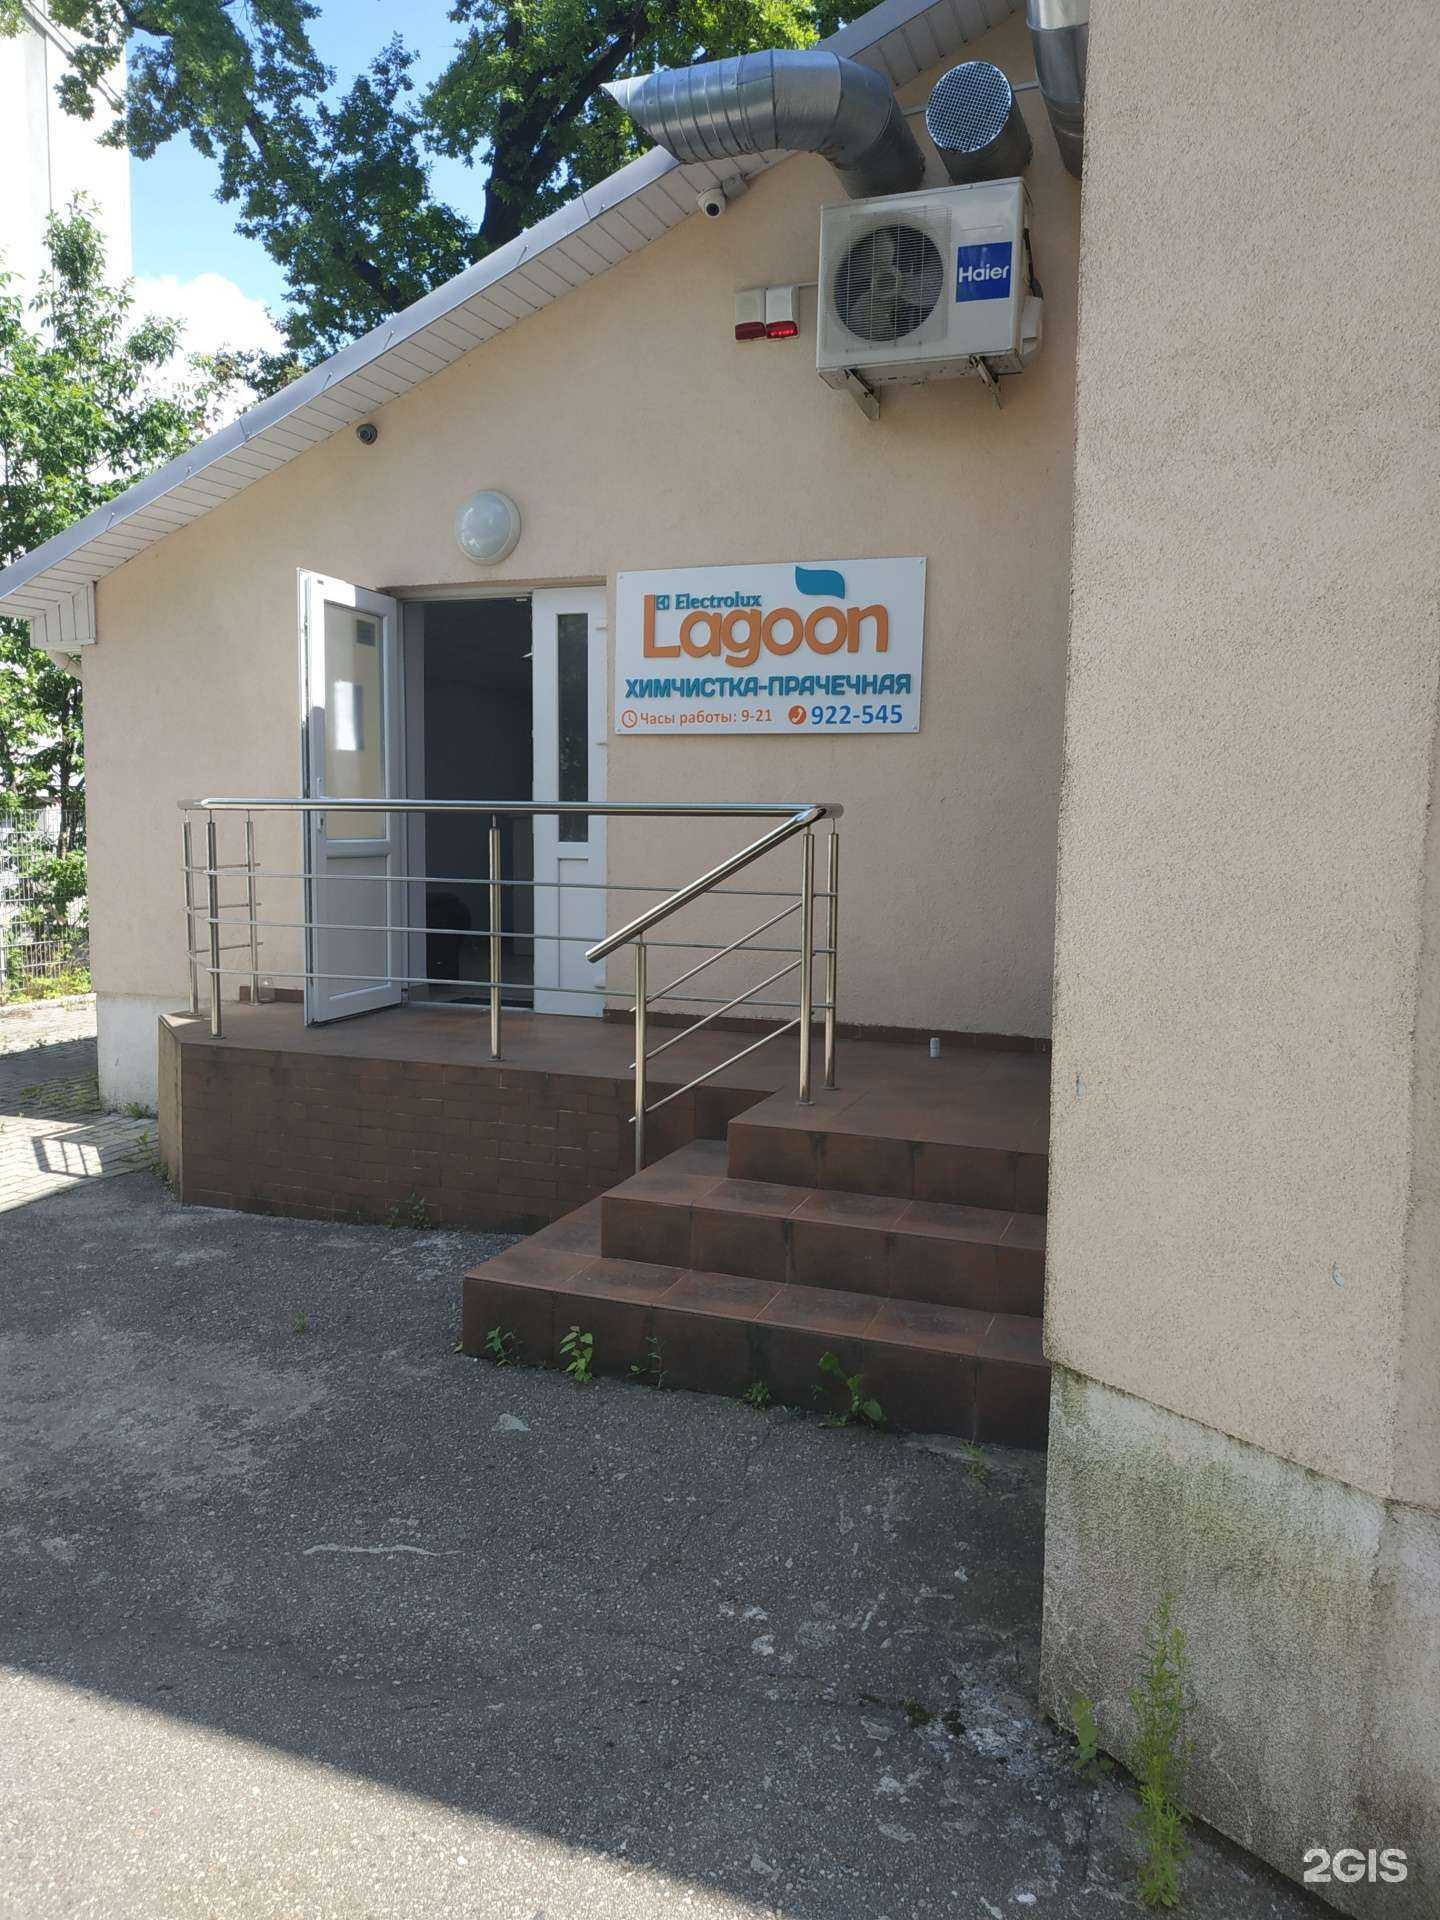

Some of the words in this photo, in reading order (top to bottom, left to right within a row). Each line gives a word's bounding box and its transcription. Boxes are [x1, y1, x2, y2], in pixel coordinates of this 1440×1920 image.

[958, 264, 1010, 283] Haier
[675, 591, 762, 610] Electrolux
[643, 594, 889, 668] Lagoon
[625, 673, 912, 699] ХИМЧИСТКА-ПРАЧЕЧНАЯ
[640, 711, 675, 725] Часы
[679, 709, 737, 727] работы:
[741, 709, 773, 722] 9-21
[811, 704, 903, 726] 922-545
